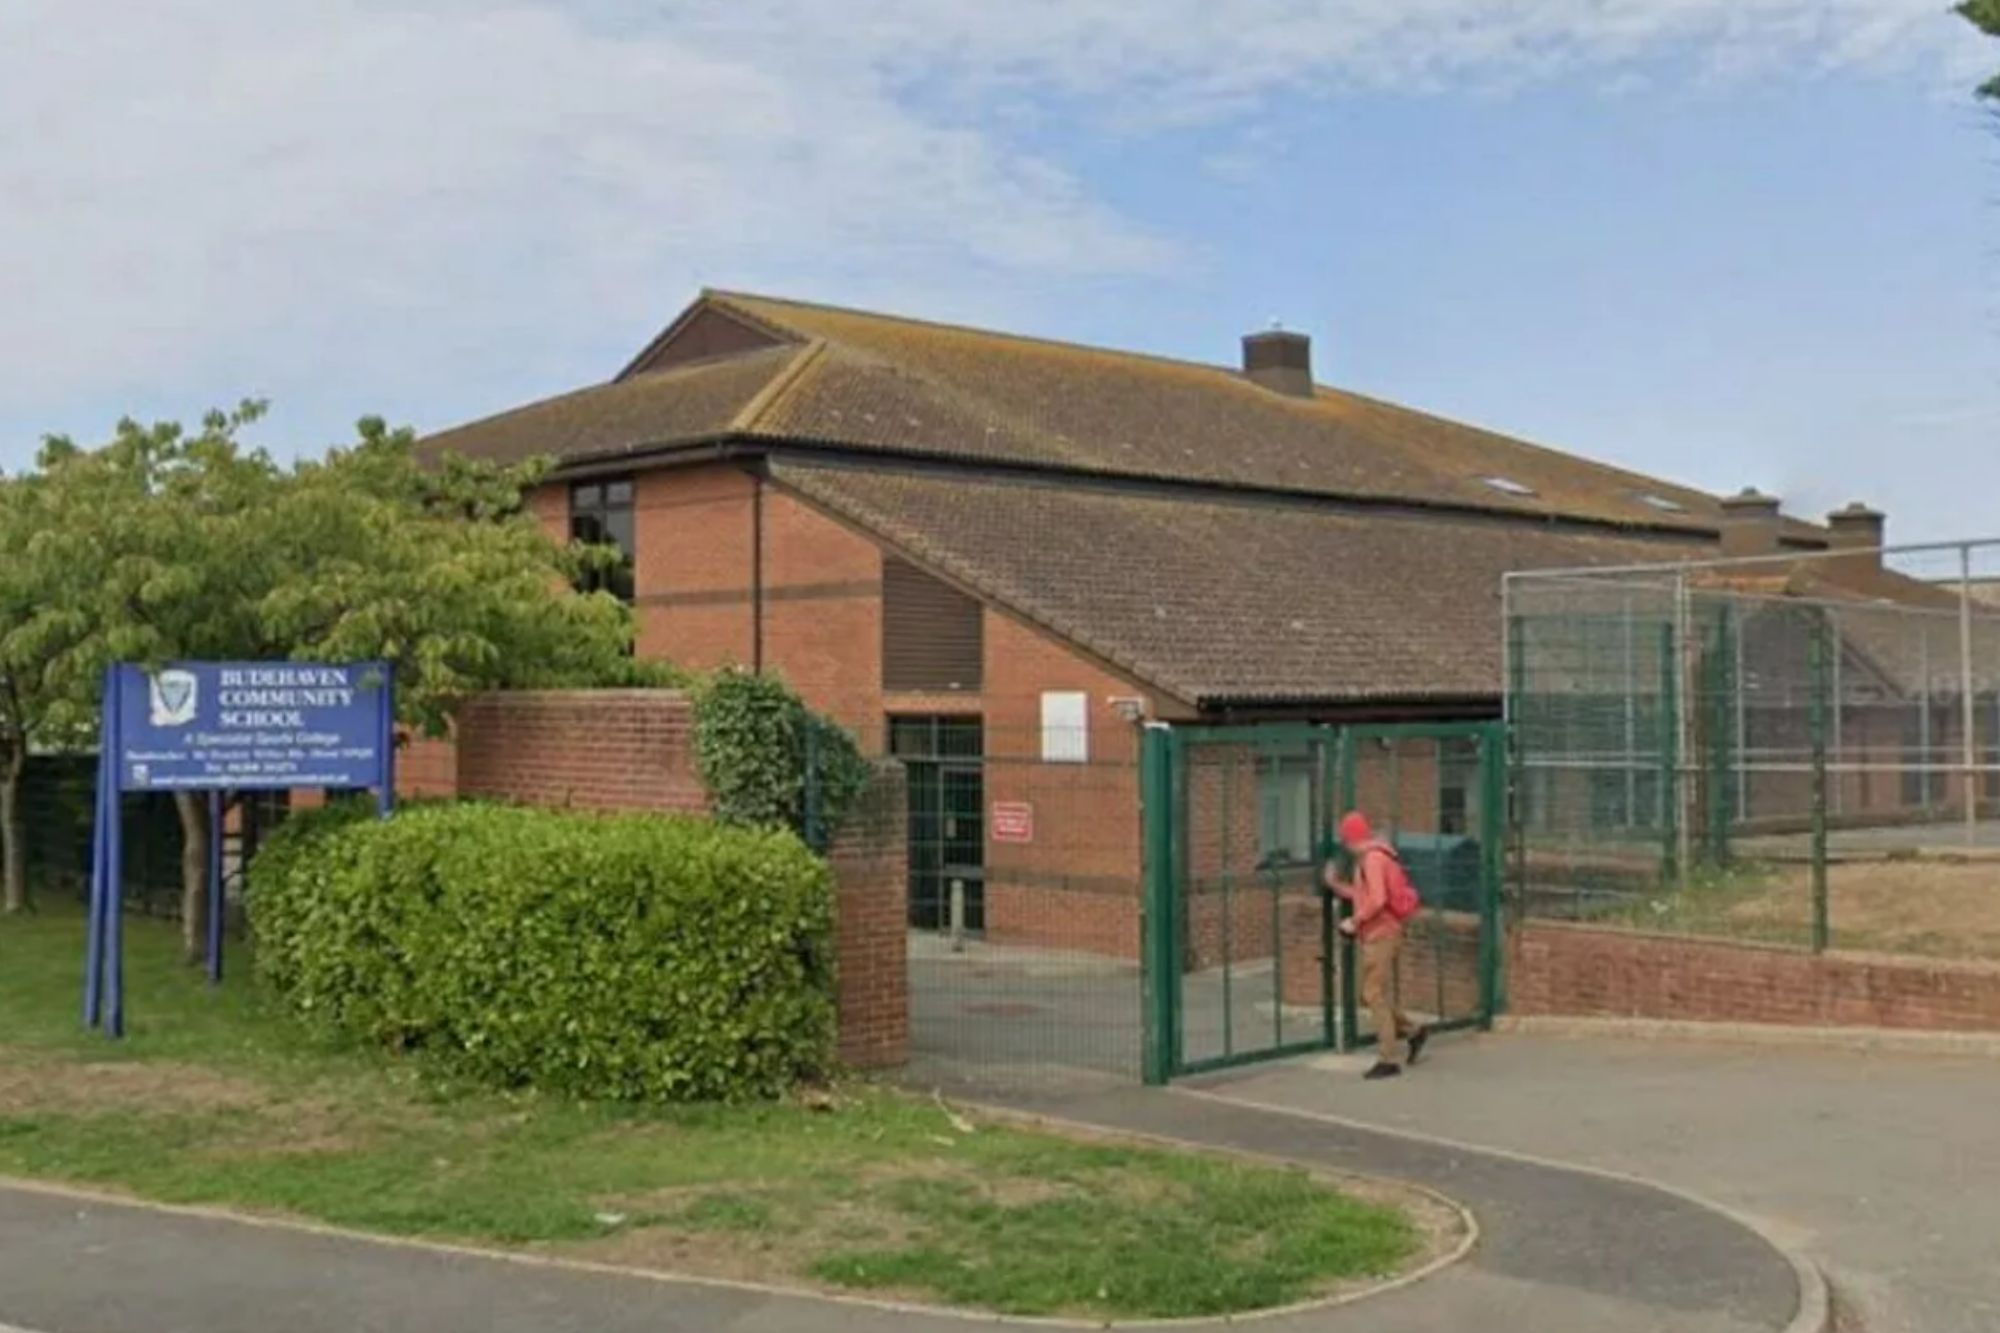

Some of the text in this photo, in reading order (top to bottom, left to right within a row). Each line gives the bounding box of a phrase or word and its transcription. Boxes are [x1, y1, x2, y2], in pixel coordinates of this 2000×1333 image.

[220, 668, 348, 686] BUDEHAVEN
[218, 689, 353, 707] COMMUNITY
[219, 710, 304, 727] SCHOOL
[296, 731, 340, 747] College
